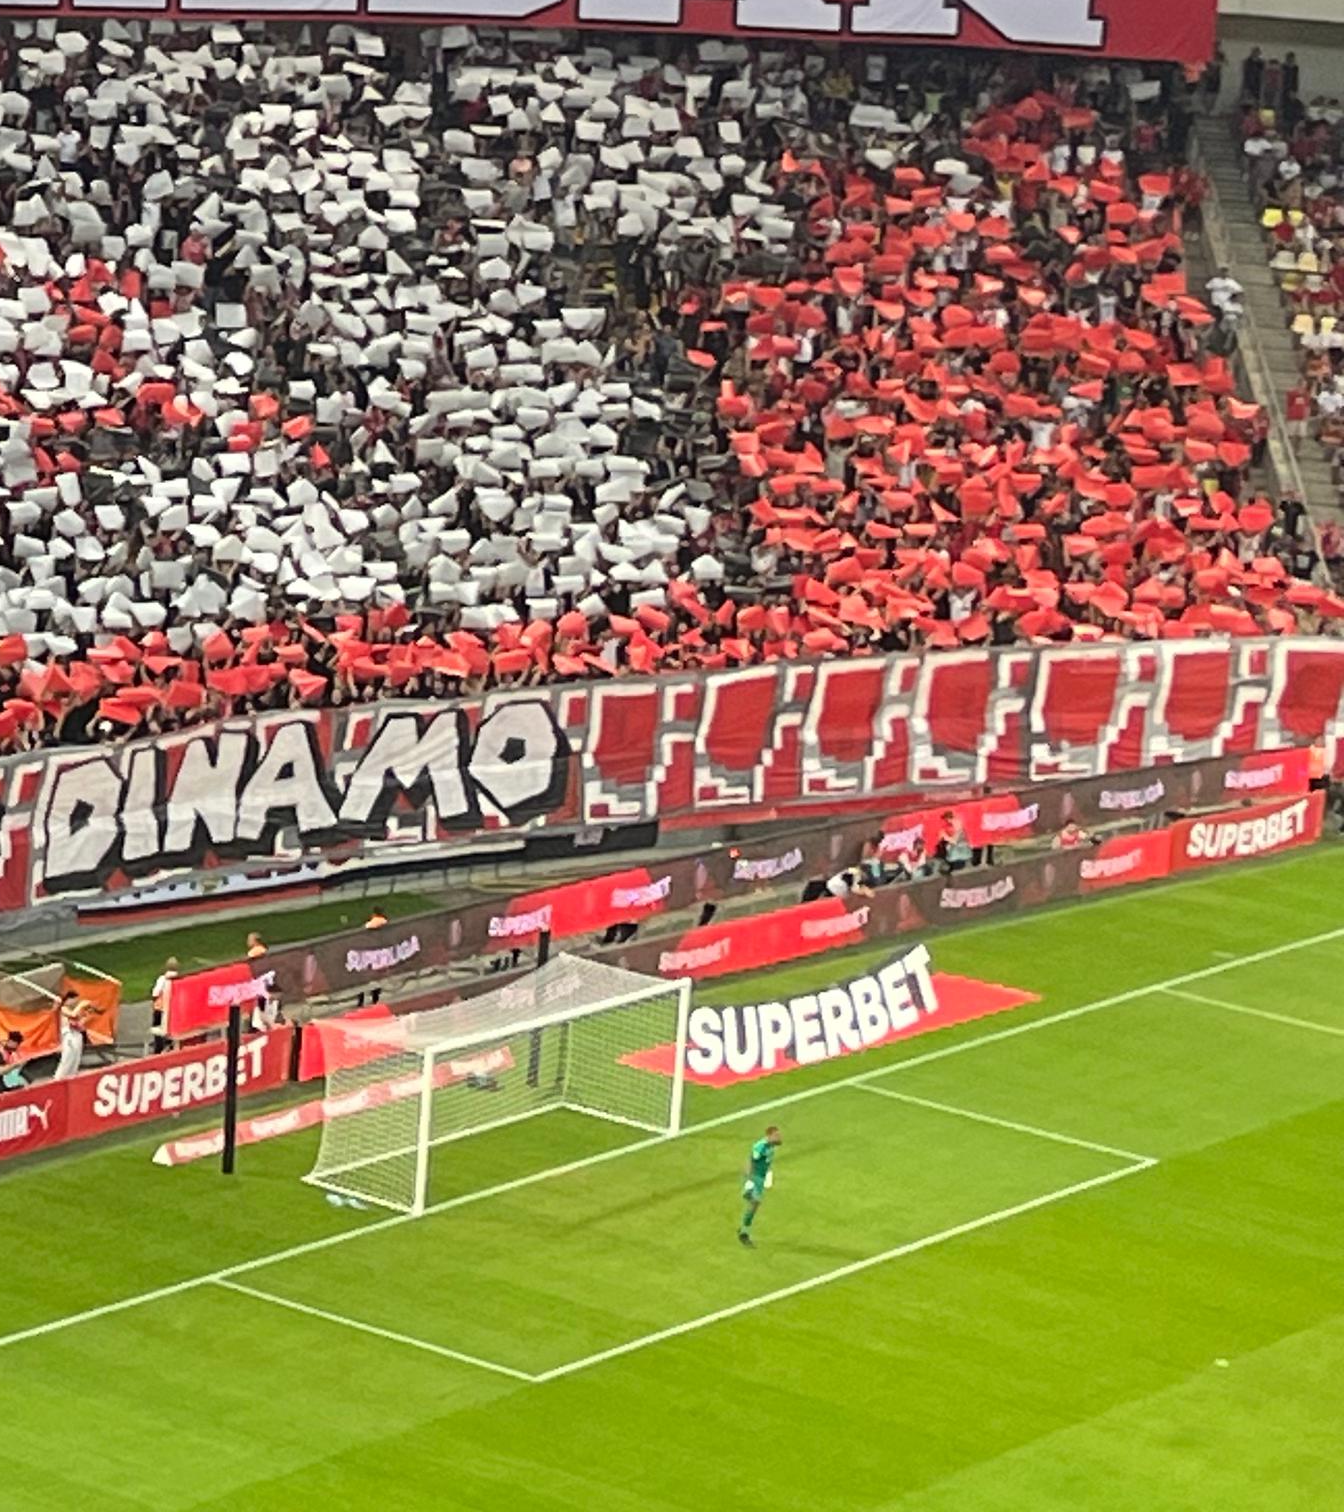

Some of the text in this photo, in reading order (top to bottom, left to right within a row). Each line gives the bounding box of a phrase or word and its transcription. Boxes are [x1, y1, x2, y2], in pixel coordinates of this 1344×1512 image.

[43, 699, 571, 880] DINAMO
[1185, 798, 1309, 860] SUPERBET
[686, 943, 940, 1075] SUPERBET
